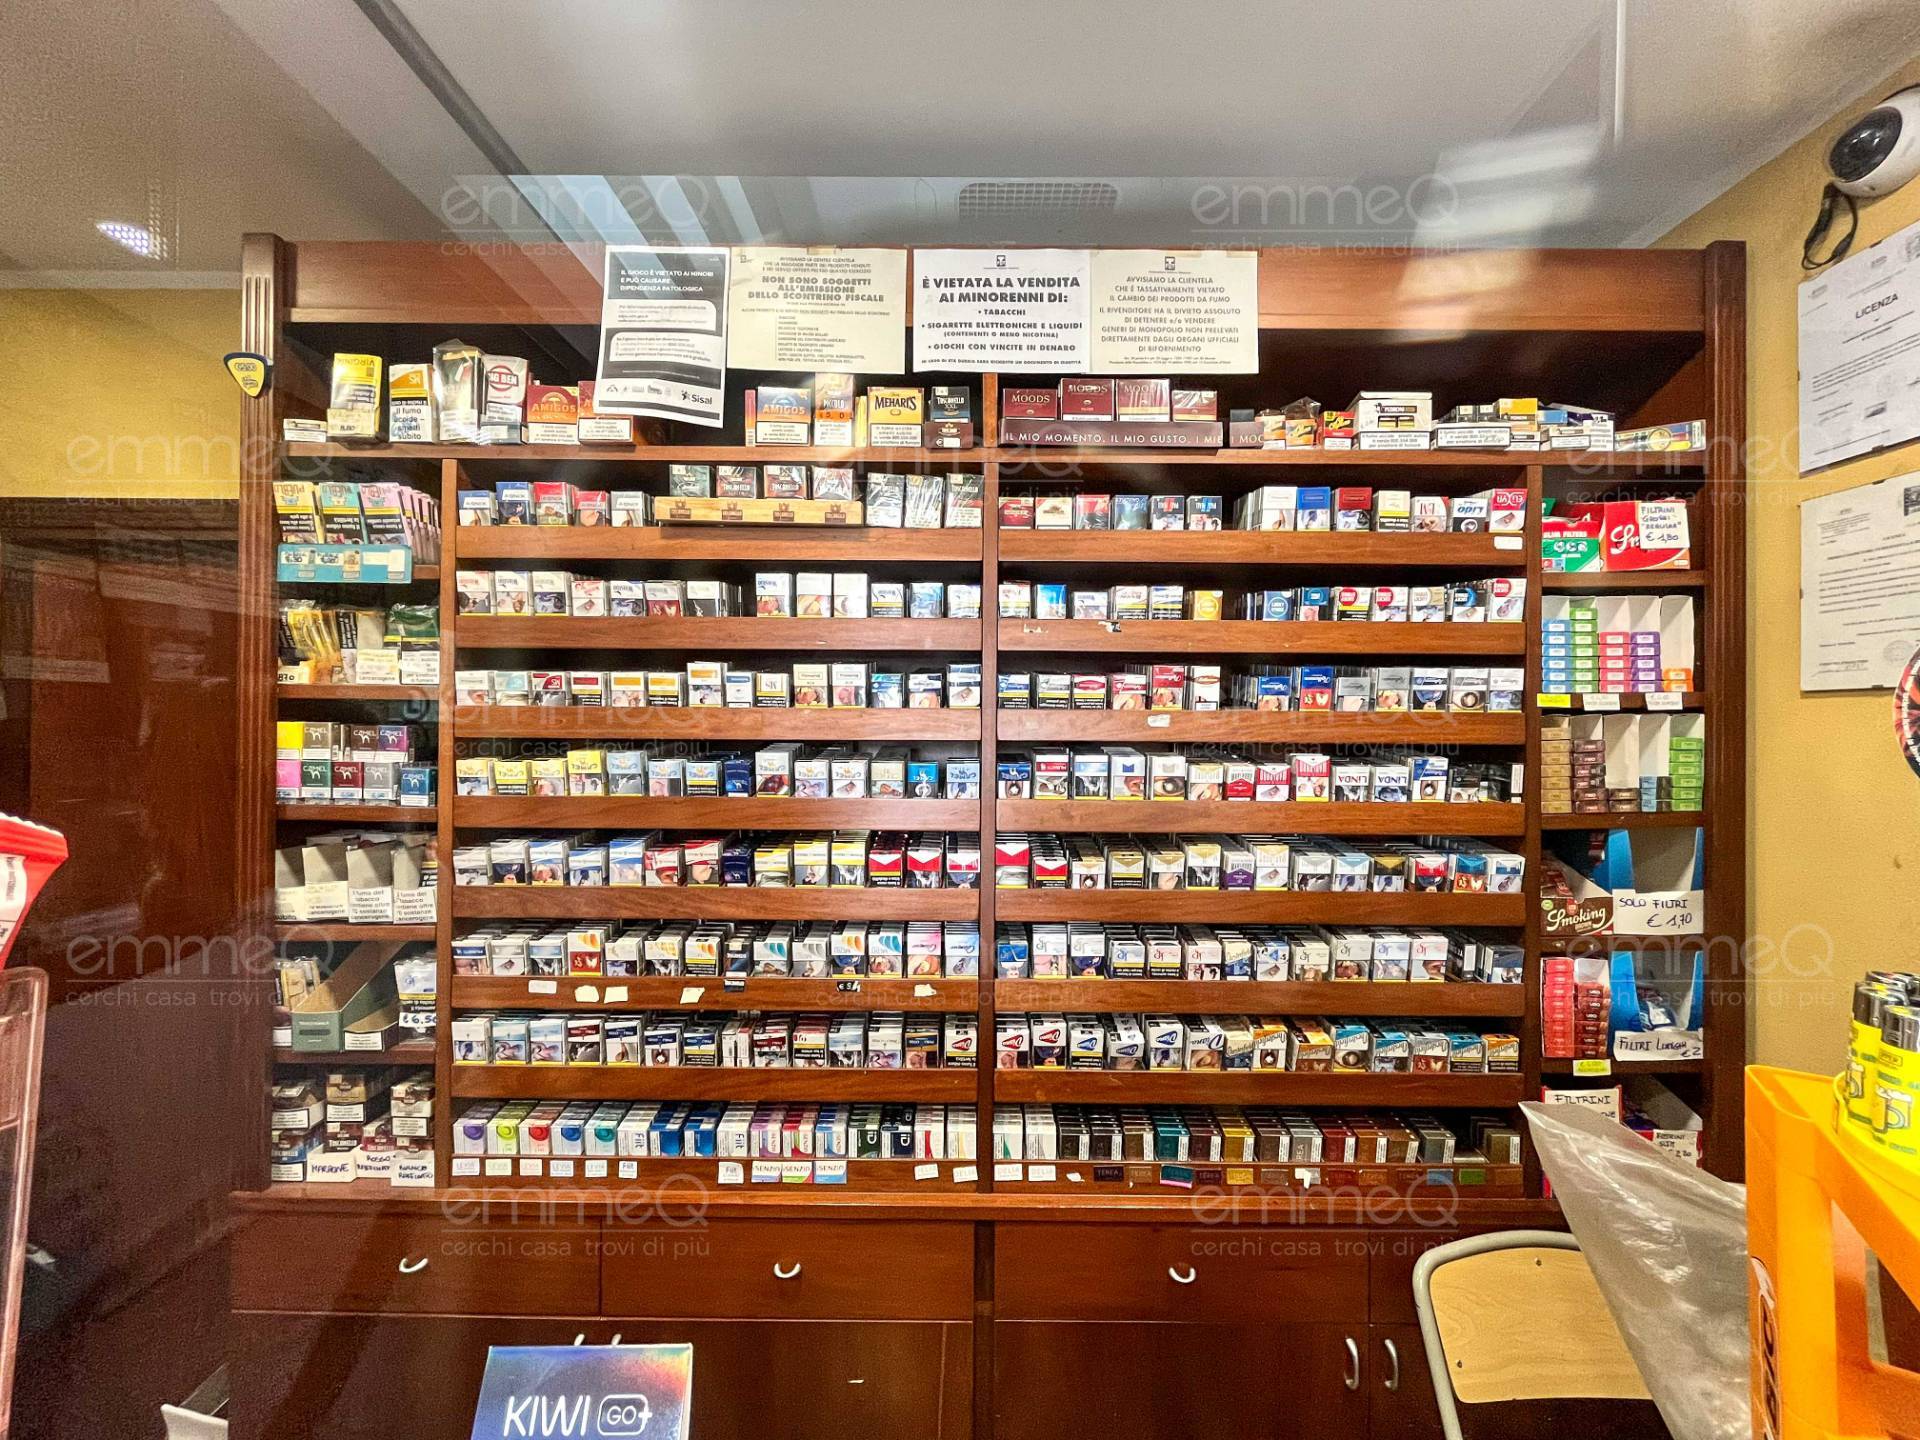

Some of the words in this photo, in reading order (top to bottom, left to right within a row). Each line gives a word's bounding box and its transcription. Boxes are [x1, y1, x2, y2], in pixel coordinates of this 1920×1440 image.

[762, 275, 785, 284] NON
[789, 276, 818, 285] SONO
[822, 277, 871, 286] SOGGETTI
[922, 276, 930, 289] È
[933, 277, 993, 289] VIETATA
[996, 278, 1014, 288] LA
[1016, 277, 1081, 288] VENDITA
[747, 291, 779, 299] DELLO
[783, 291, 842, 301] SCONTRINO
[845, 293, 885, 302] FISCALE
[939, 293, 955, 303] AI
[958, 292, 1044, 303] MINORENNI
[1047, 293, 1068, 303] DI:
[1855, 292, 1899, 320] LICENZA
[1049, 322, 1083, 330] LIQUIDI
[500, 373, 518, 386] BEN
[691, 394, 713, 405] Sisal
[1011, 393, 1050, 404] MOODS
[403, 407, 422, 415] fumo
[531, 403, 577, 414] AMIGOS
[762, 404, 806, 416] AMIGOS
[1005, 432, 1016, 442] IL
[1018, 432, 1040, 442] MIO
[1044, 433, 1106, 444] MOMENTO.
[1110, 434, 1120, 443] IL
[1123, 434, 1145, 443] MIO
[1149, 434, 1187, 444] GUSTO.
[1457, 504, 1485, 515] Lido
[1640, 506, 1676, 514] FILTRINI
[1645, 532, 1655, 542] €
[304, 725, 328, 735] CAMEL
[353, 728, 378, 738] CAMEL
[379, 728, 404, 738] CAMEL
[302, 765, 328, 774] CAMEL
[334, 765, 358, 774] CAMEL
[365, 765, 390, 774] CAMEL
[402, 773, 427, 781] CAMEL
[1618, 897, 1647, 909] SOLO
[1652, 898, 1688, 910] FILTRI
[1546, 906, 1606, 933] Smoking
[1646, 914, 1662, 928] €
[1666, 912, 1693, 930] 1,70
[1190, 1033, 1223, 1051] Diana
[1253, 1030, 1286, 1049] Chesterfield
[1618, 1036, 1650, 1051] FILTRI
[1681, 1048, 1690, 1058] €
[1692, 1048, 1701, 1057] 2
[1554, 1094, 1611, 1106] FILTRINI
[621, 1161, 634, 1170] Fiit
[503, 1394, 591, 1438] KIWI
